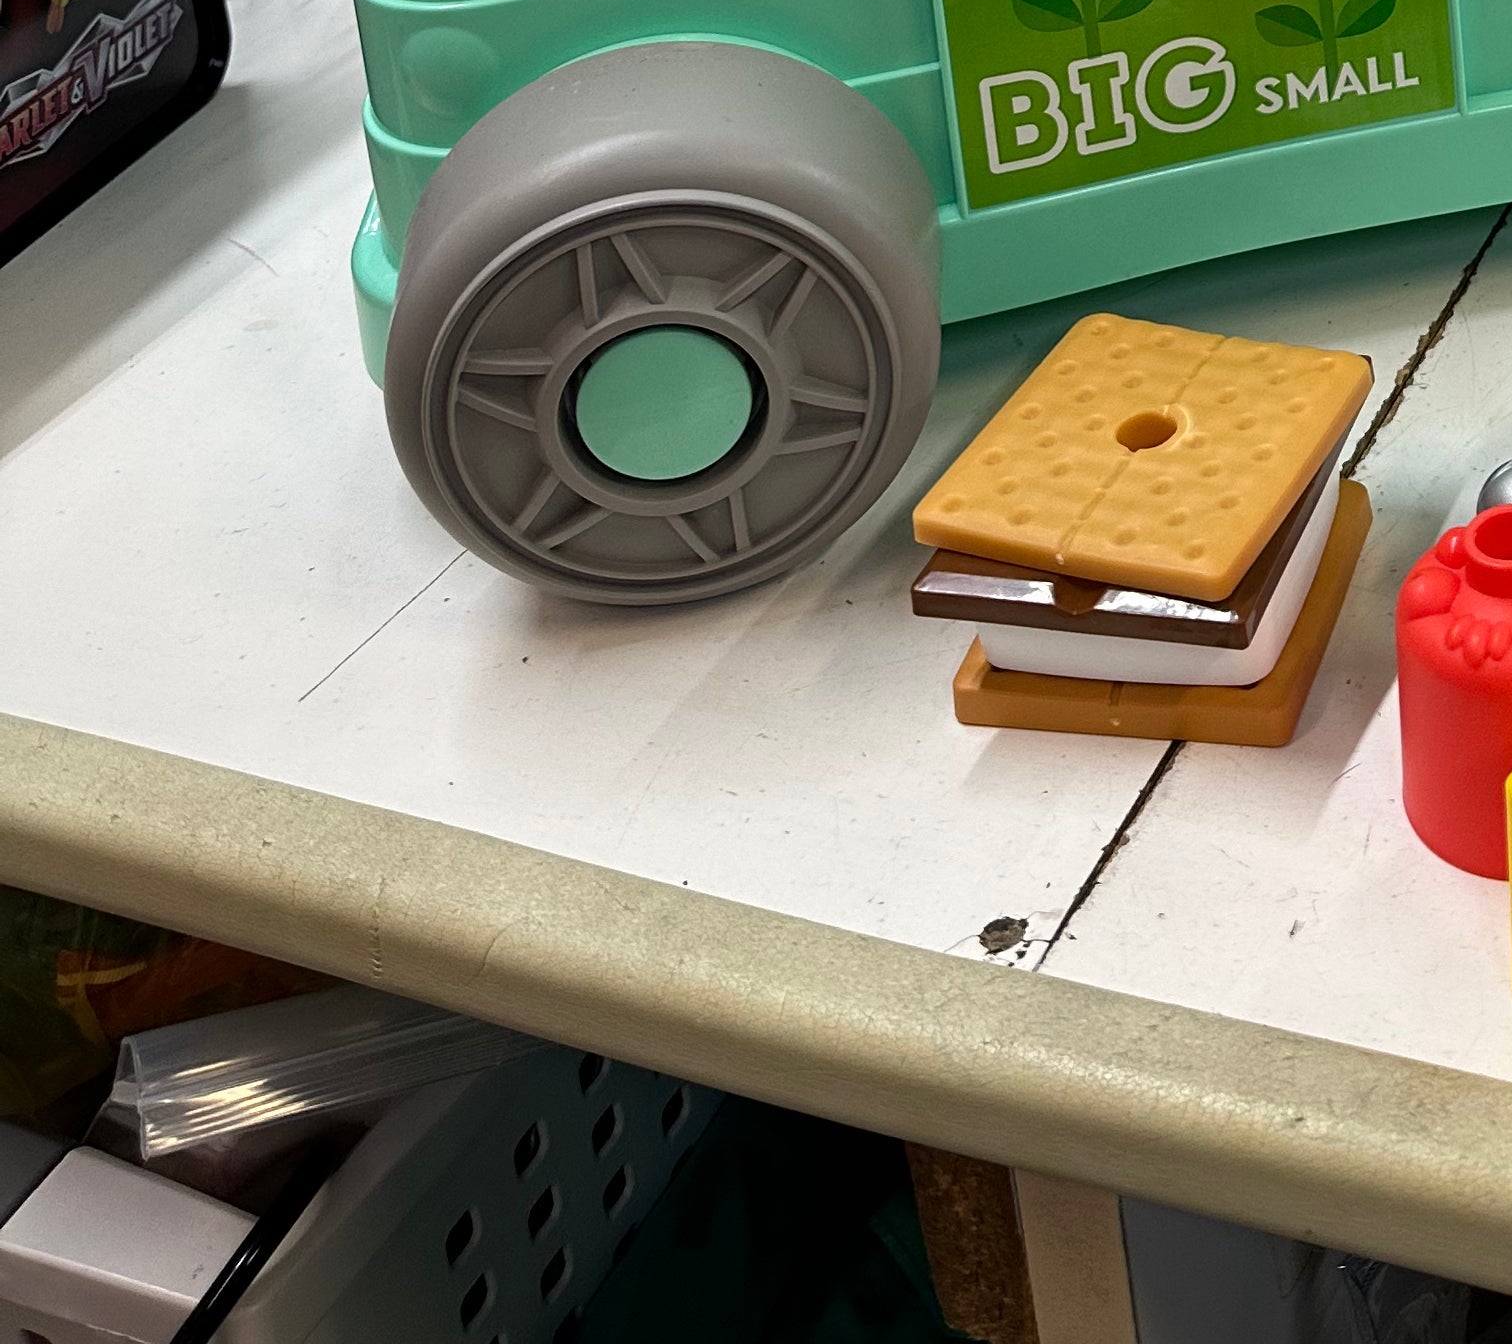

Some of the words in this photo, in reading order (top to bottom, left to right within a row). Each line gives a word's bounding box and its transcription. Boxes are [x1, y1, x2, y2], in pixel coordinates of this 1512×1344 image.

[73, 1, 174, 103] VIOLET
[979, 36, 1236, 174] BIG
[1255, 52, 1420, 114] SMALL
